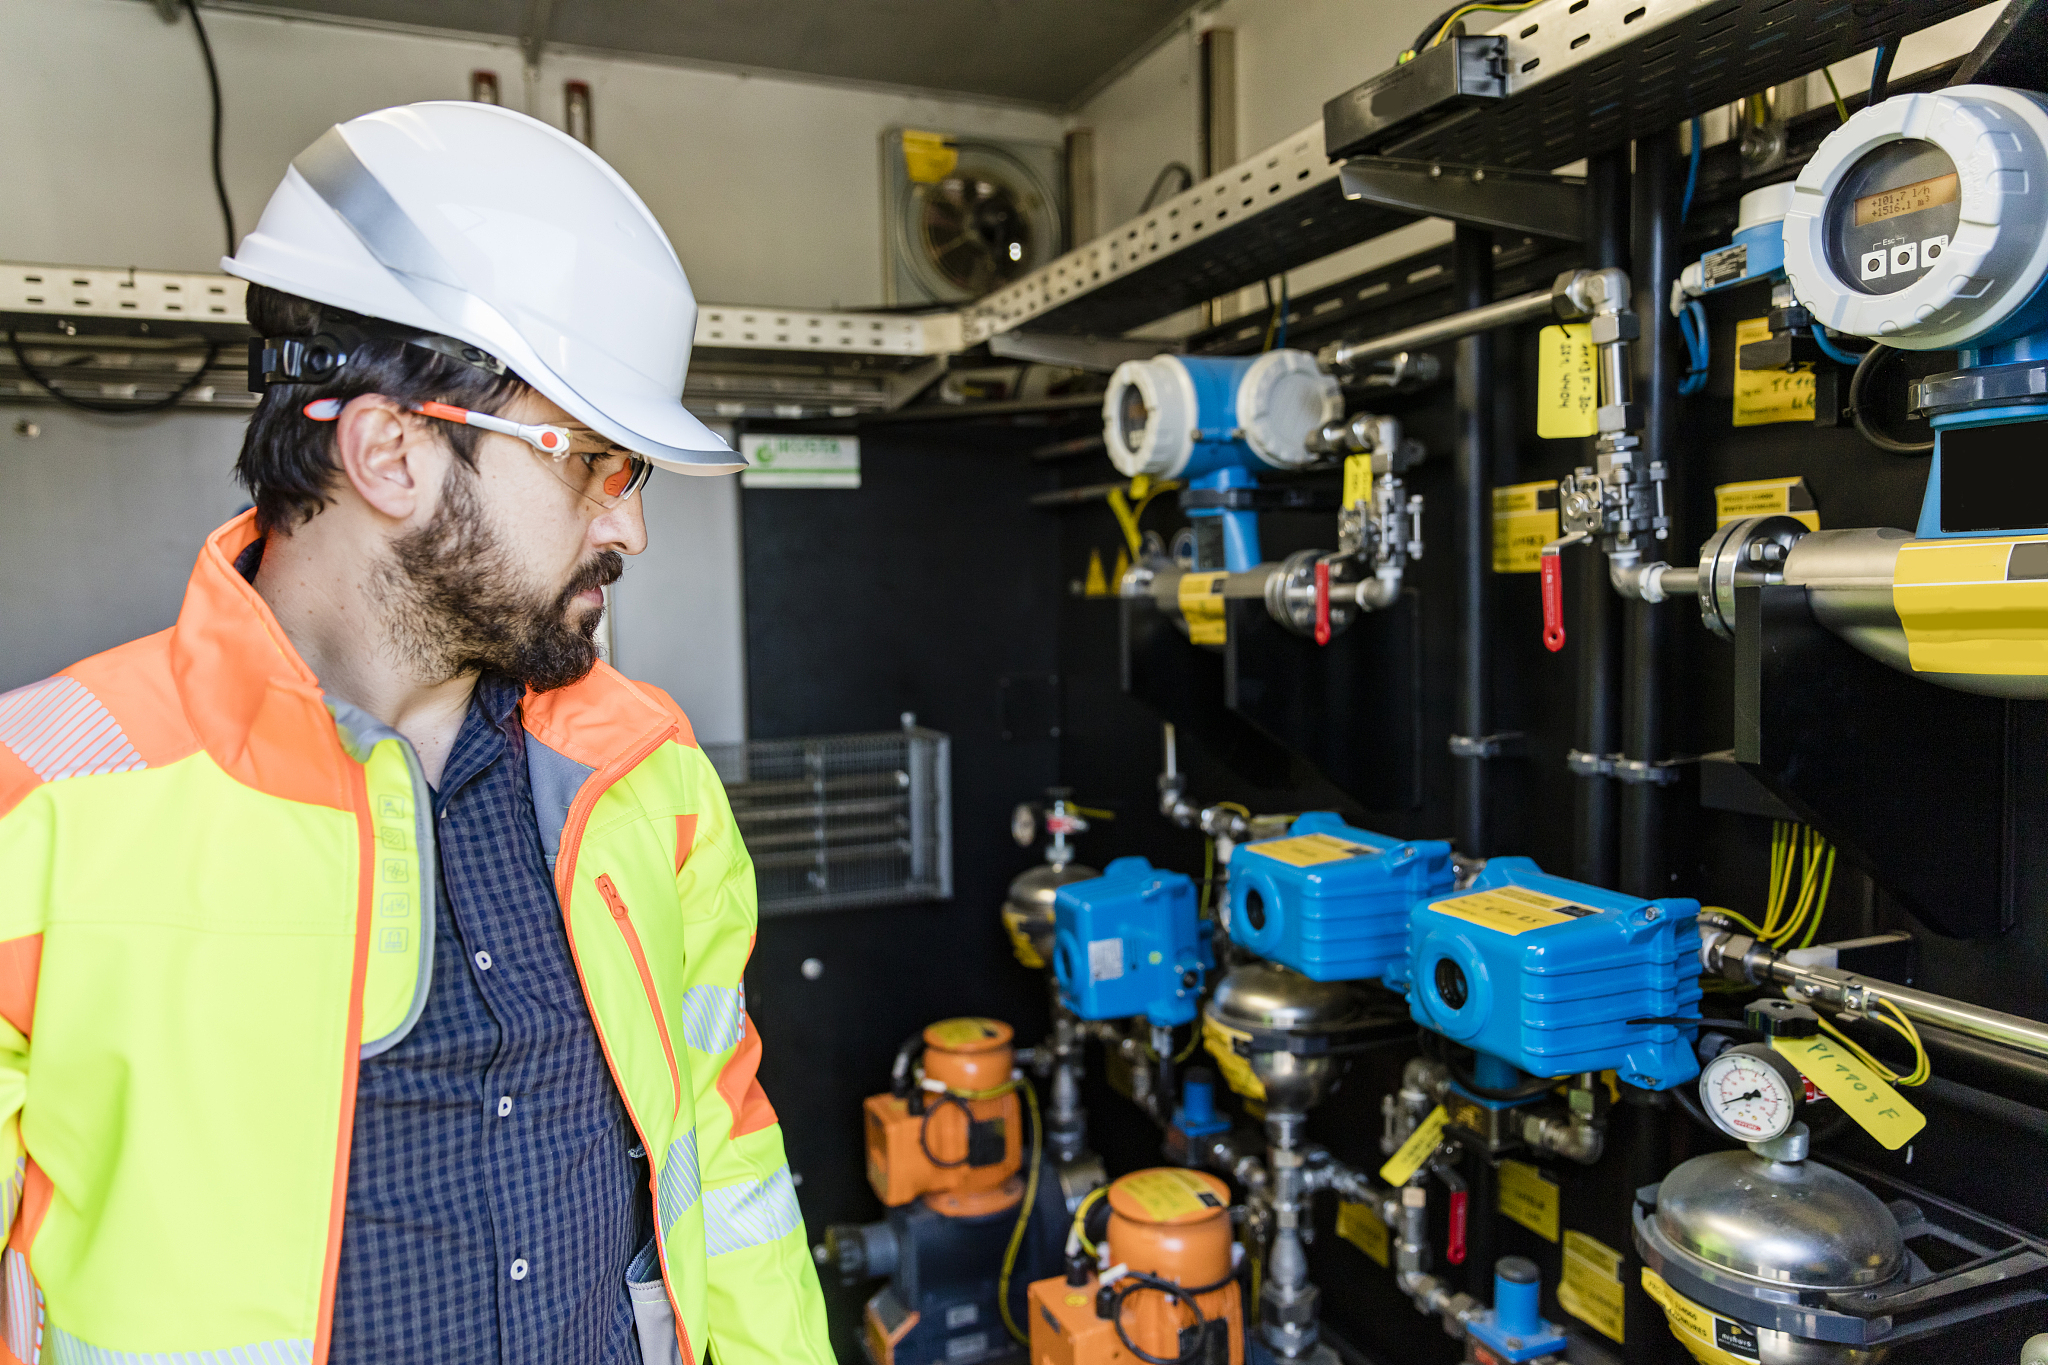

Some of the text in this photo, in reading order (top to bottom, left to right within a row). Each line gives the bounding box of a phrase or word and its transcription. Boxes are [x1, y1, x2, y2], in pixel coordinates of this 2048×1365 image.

[1872, 191, 1906, 207] +101.7
[1872, 200, 1911, 217] +1516.1
[1882, 238, 1896, 246] Esc
[1940, 237, 1946, 245] E
[1835, 1063, 1879, 1103] 1103
[1877, 1107, 1900, 1119] F
